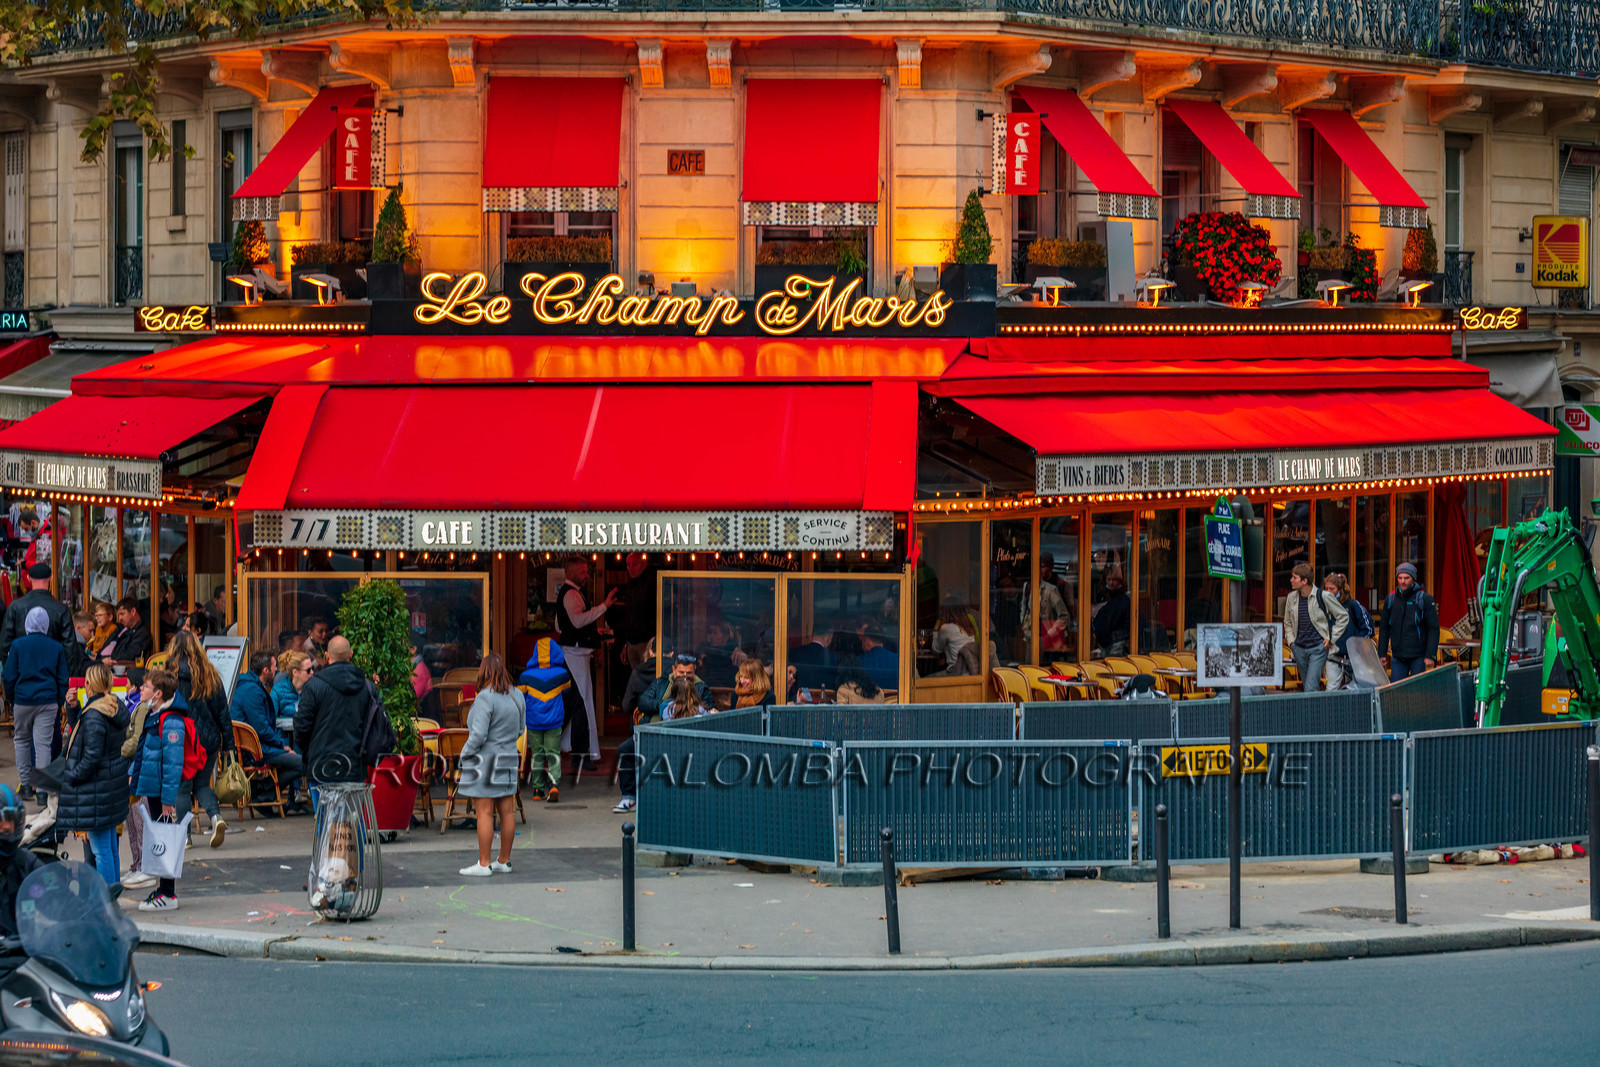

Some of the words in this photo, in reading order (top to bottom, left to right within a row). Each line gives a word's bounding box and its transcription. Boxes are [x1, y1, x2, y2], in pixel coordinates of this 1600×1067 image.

[669, 152, 703, 172] CAFE
[1537, 270, 1579, 282] Kodak
[414, 272, 512, 325] Le
[519, 272, 746, 336] Champ
[755, 274, 954, 336] Mars
[0, 313, 28, 329] RIA
[140, 306, 210, 331] Café
[765, 296, 799, 326] de
[1460, 306, 1522, 330] Café
[1279, 459, 1290, 481] LE
[1291, 457, 1322, 481] CHAMP
[1324, 457, 1335, 479] DE
[1337, 455, 1362, 478] MARS
[1495, 448, 1534, 467] COCKTAILS
[37, 462, 46, 485] LE
[46, 463, 75, 488] CHAMPS
[77, 465, 86, 489] DE
[87, 465, 107, 490] MARS
[116, 471, 151, 493] BRASSERIE
[1063, 465, 1084, 487] VINS
[1094, 464, 1125, 486] BIERES
[290, 518, 331, 543] 7/7
[421, 520, 473, 545] CAFE
[570, 522, 704, 546] RESTAURANT
[803, 518, 848, 530] SERVICE
[1218, 522, 1231, 535] PLACE
[802, 534, 850, 547] CONTINU
[1177, 749, 1253, 772] PIETOS
